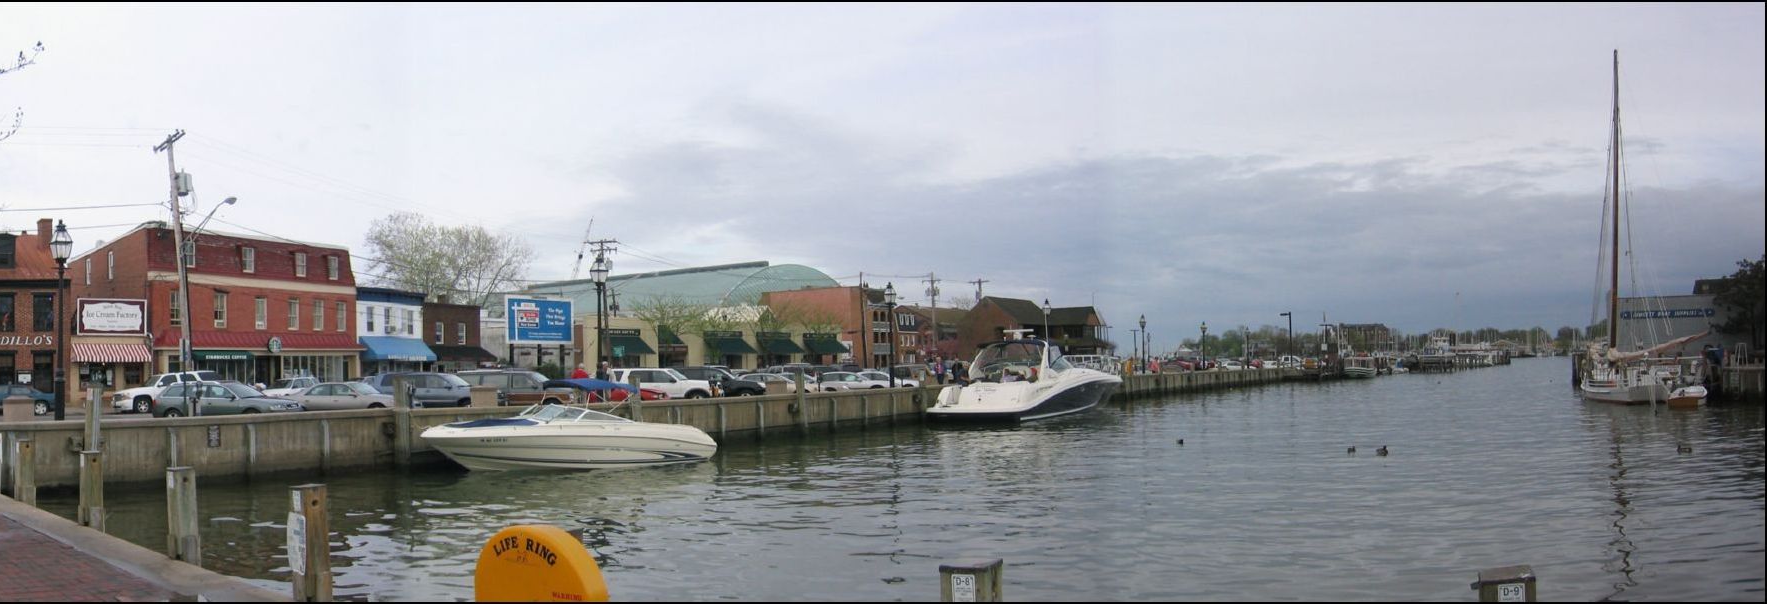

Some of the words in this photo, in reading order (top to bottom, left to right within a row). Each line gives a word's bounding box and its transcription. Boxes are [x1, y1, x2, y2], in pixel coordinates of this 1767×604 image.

[493, 536, 518, 556] LIFE
[526, 538, 557, 566] RING
[955, 577, 970, 585] D-8
[1503, 586, 1520, 596] D-9
